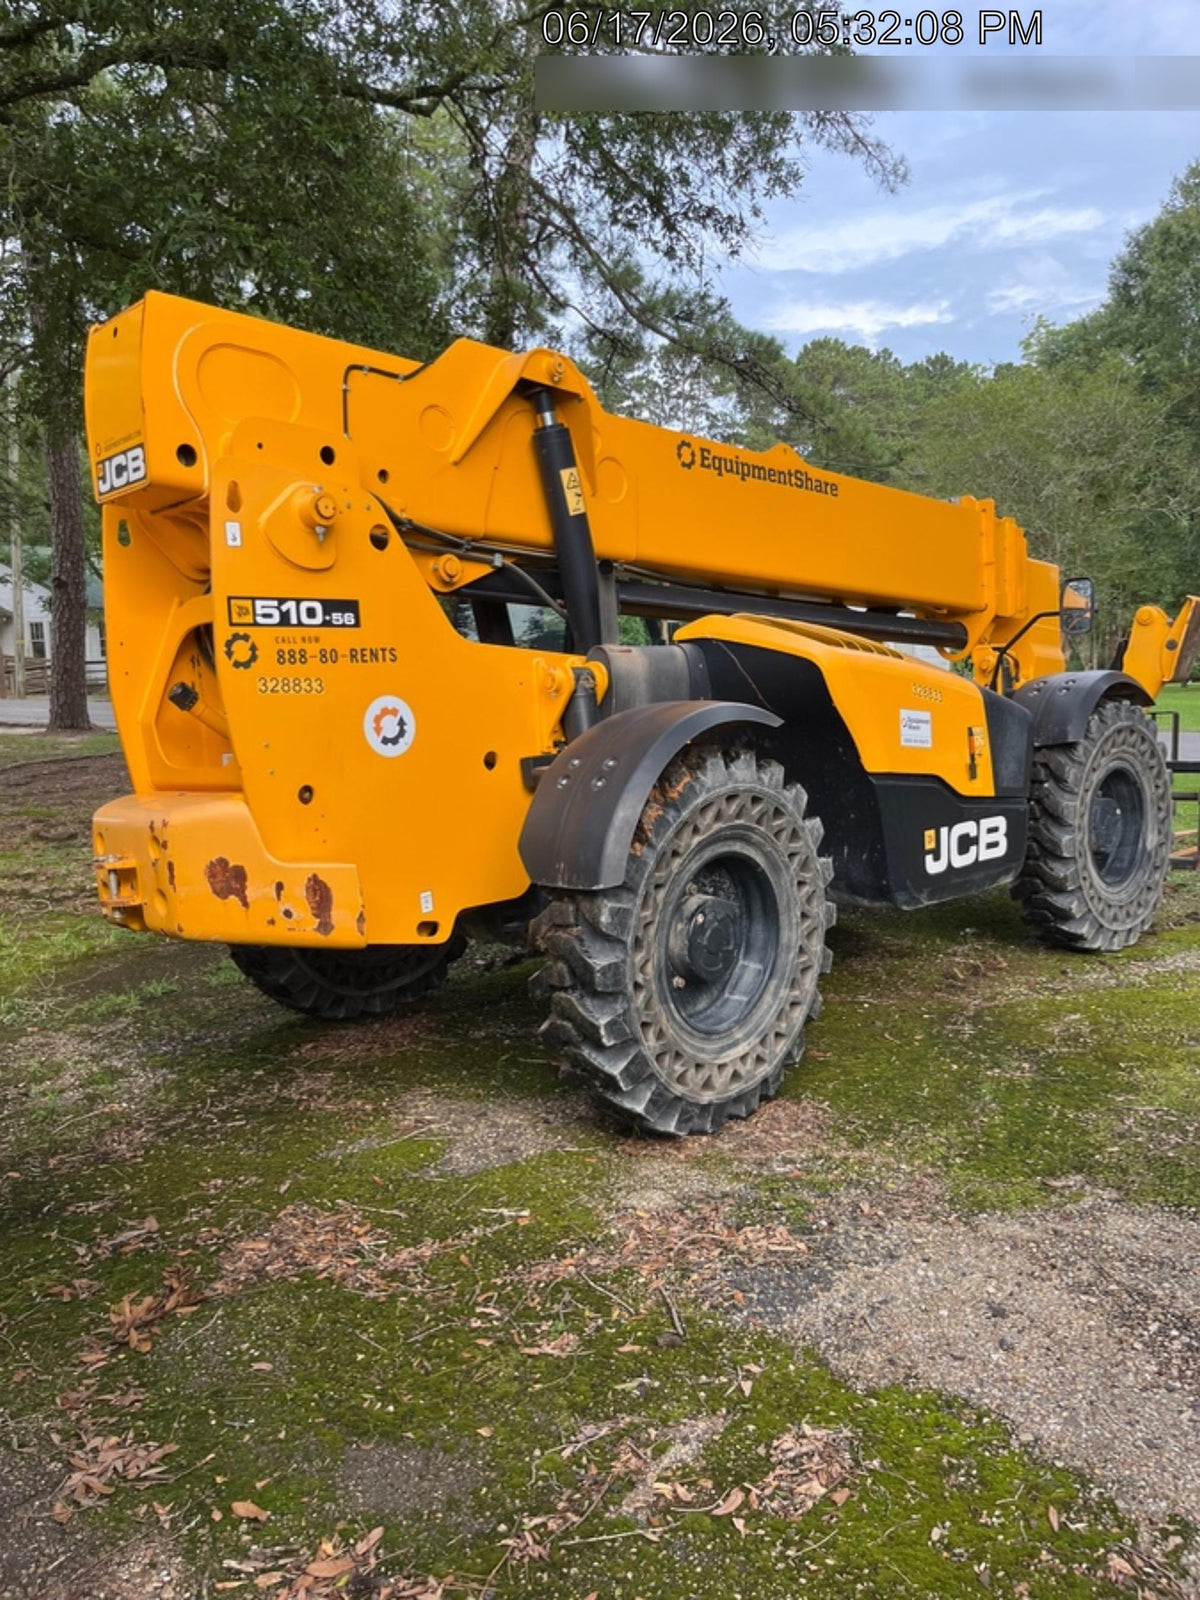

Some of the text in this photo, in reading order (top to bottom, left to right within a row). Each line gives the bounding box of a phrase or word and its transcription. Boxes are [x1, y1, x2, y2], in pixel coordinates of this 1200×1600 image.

[98, 446, 146, 493] JCB
[699, 447, 839, 497] EquipmentShare
[274, 636, 321, 645] CALL NOW
[276, 647, 398, 666] 888-80-RENTS
[258, 677, 325, 695] 328833
[924, 815, 1008, 875] JCB
